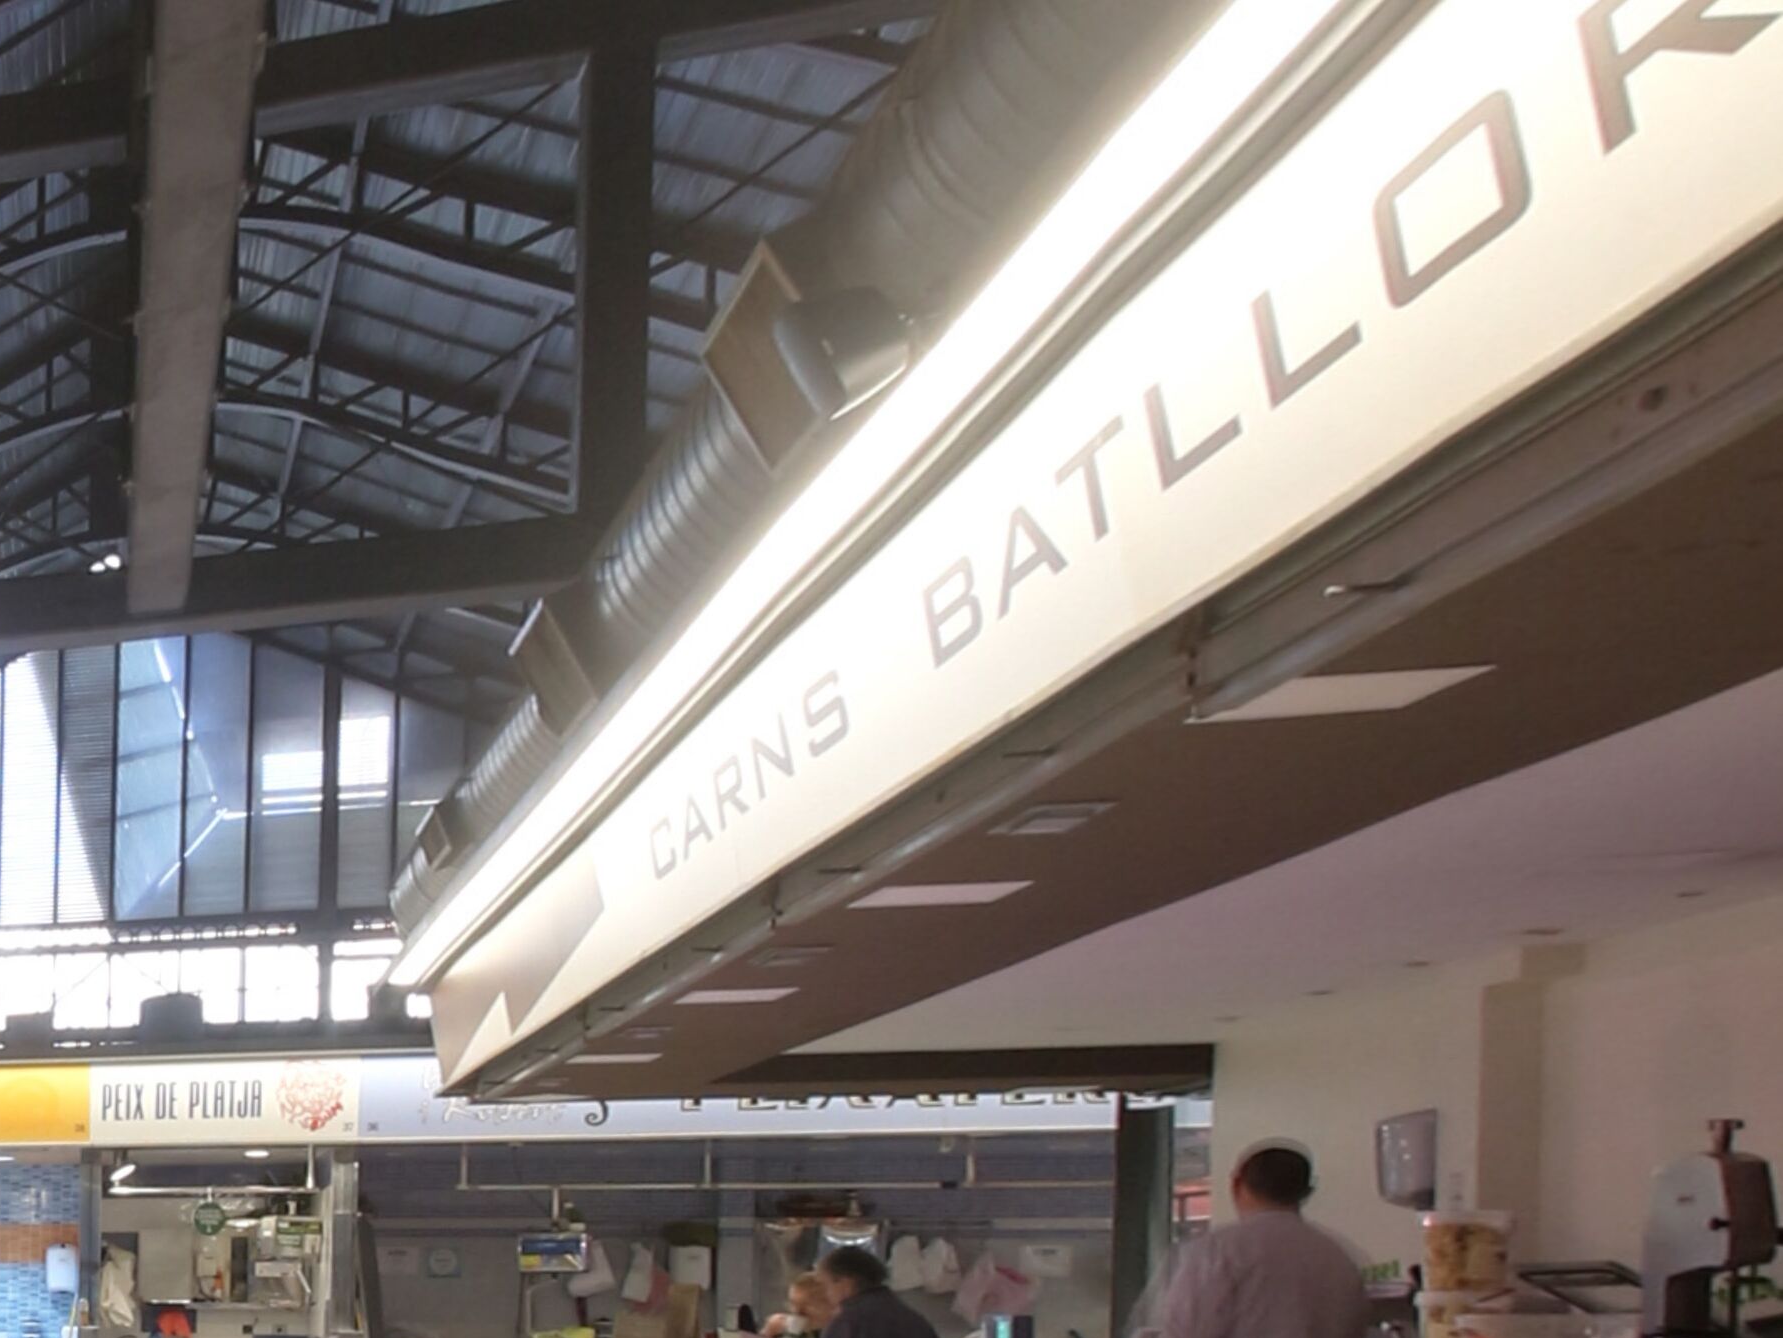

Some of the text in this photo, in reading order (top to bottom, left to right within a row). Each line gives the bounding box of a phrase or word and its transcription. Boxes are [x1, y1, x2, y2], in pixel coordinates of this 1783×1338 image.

[648, 670, 853, 881] CARNS
[101, 1083, 145, 1121] PEIX
[154, 1081, 178, 1120] DE
[188, 1079, 264, 1119] PLATJA
